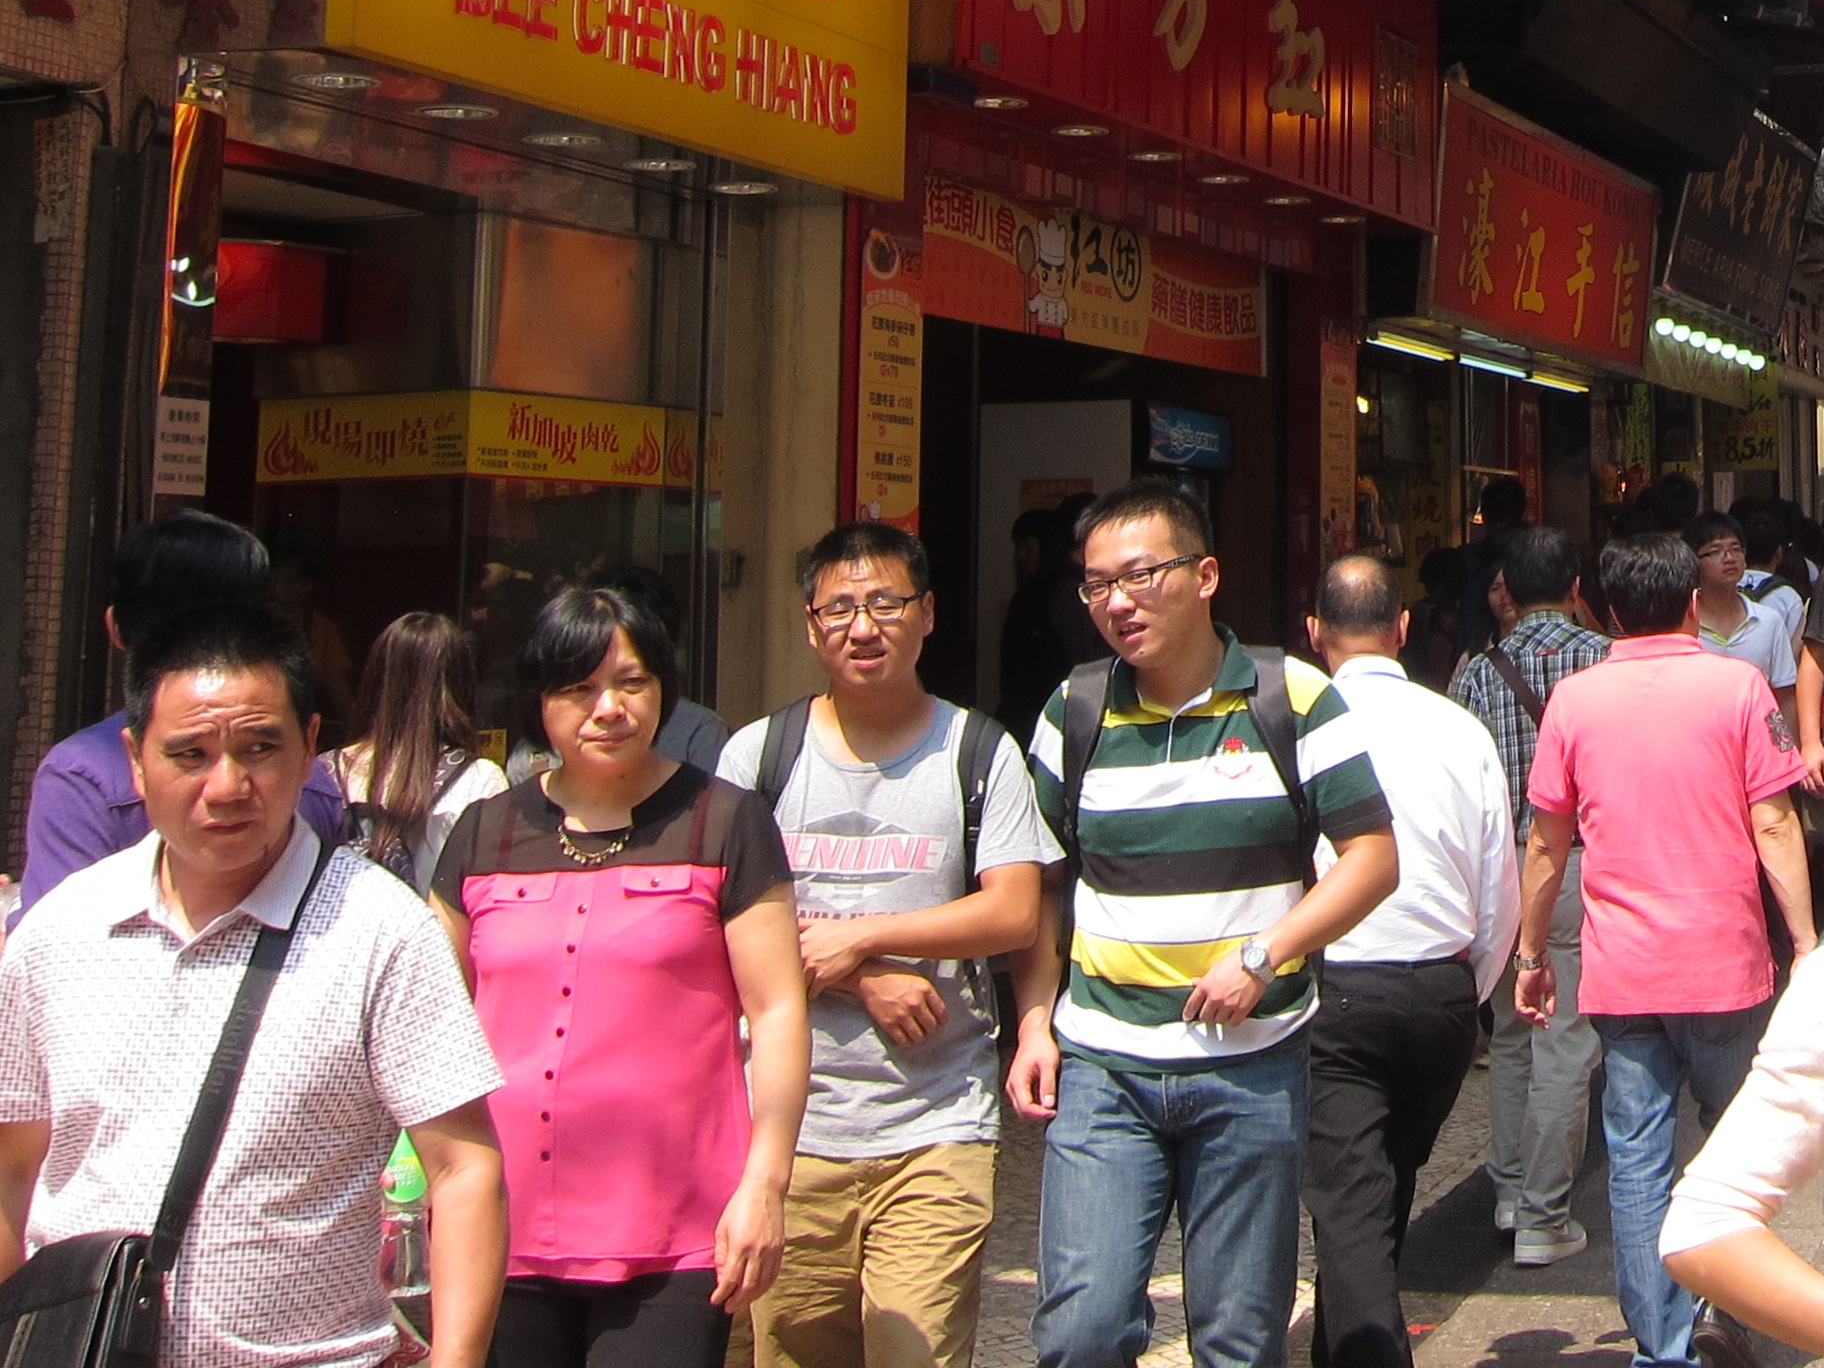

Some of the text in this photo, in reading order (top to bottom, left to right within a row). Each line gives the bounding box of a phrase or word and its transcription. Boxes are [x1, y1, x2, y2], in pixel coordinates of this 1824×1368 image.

[734, 26, 857, 135] HIANG
[1468, 117, 1566, 194] PASTELARIA
[1571, 181, 1600, 207] HOU
[923, 179, 1017, 257] 街頭小食
[1458, 165, 1641, 349] 濠江手信
[507, 401, 620, 465] 新加坡肉乾
